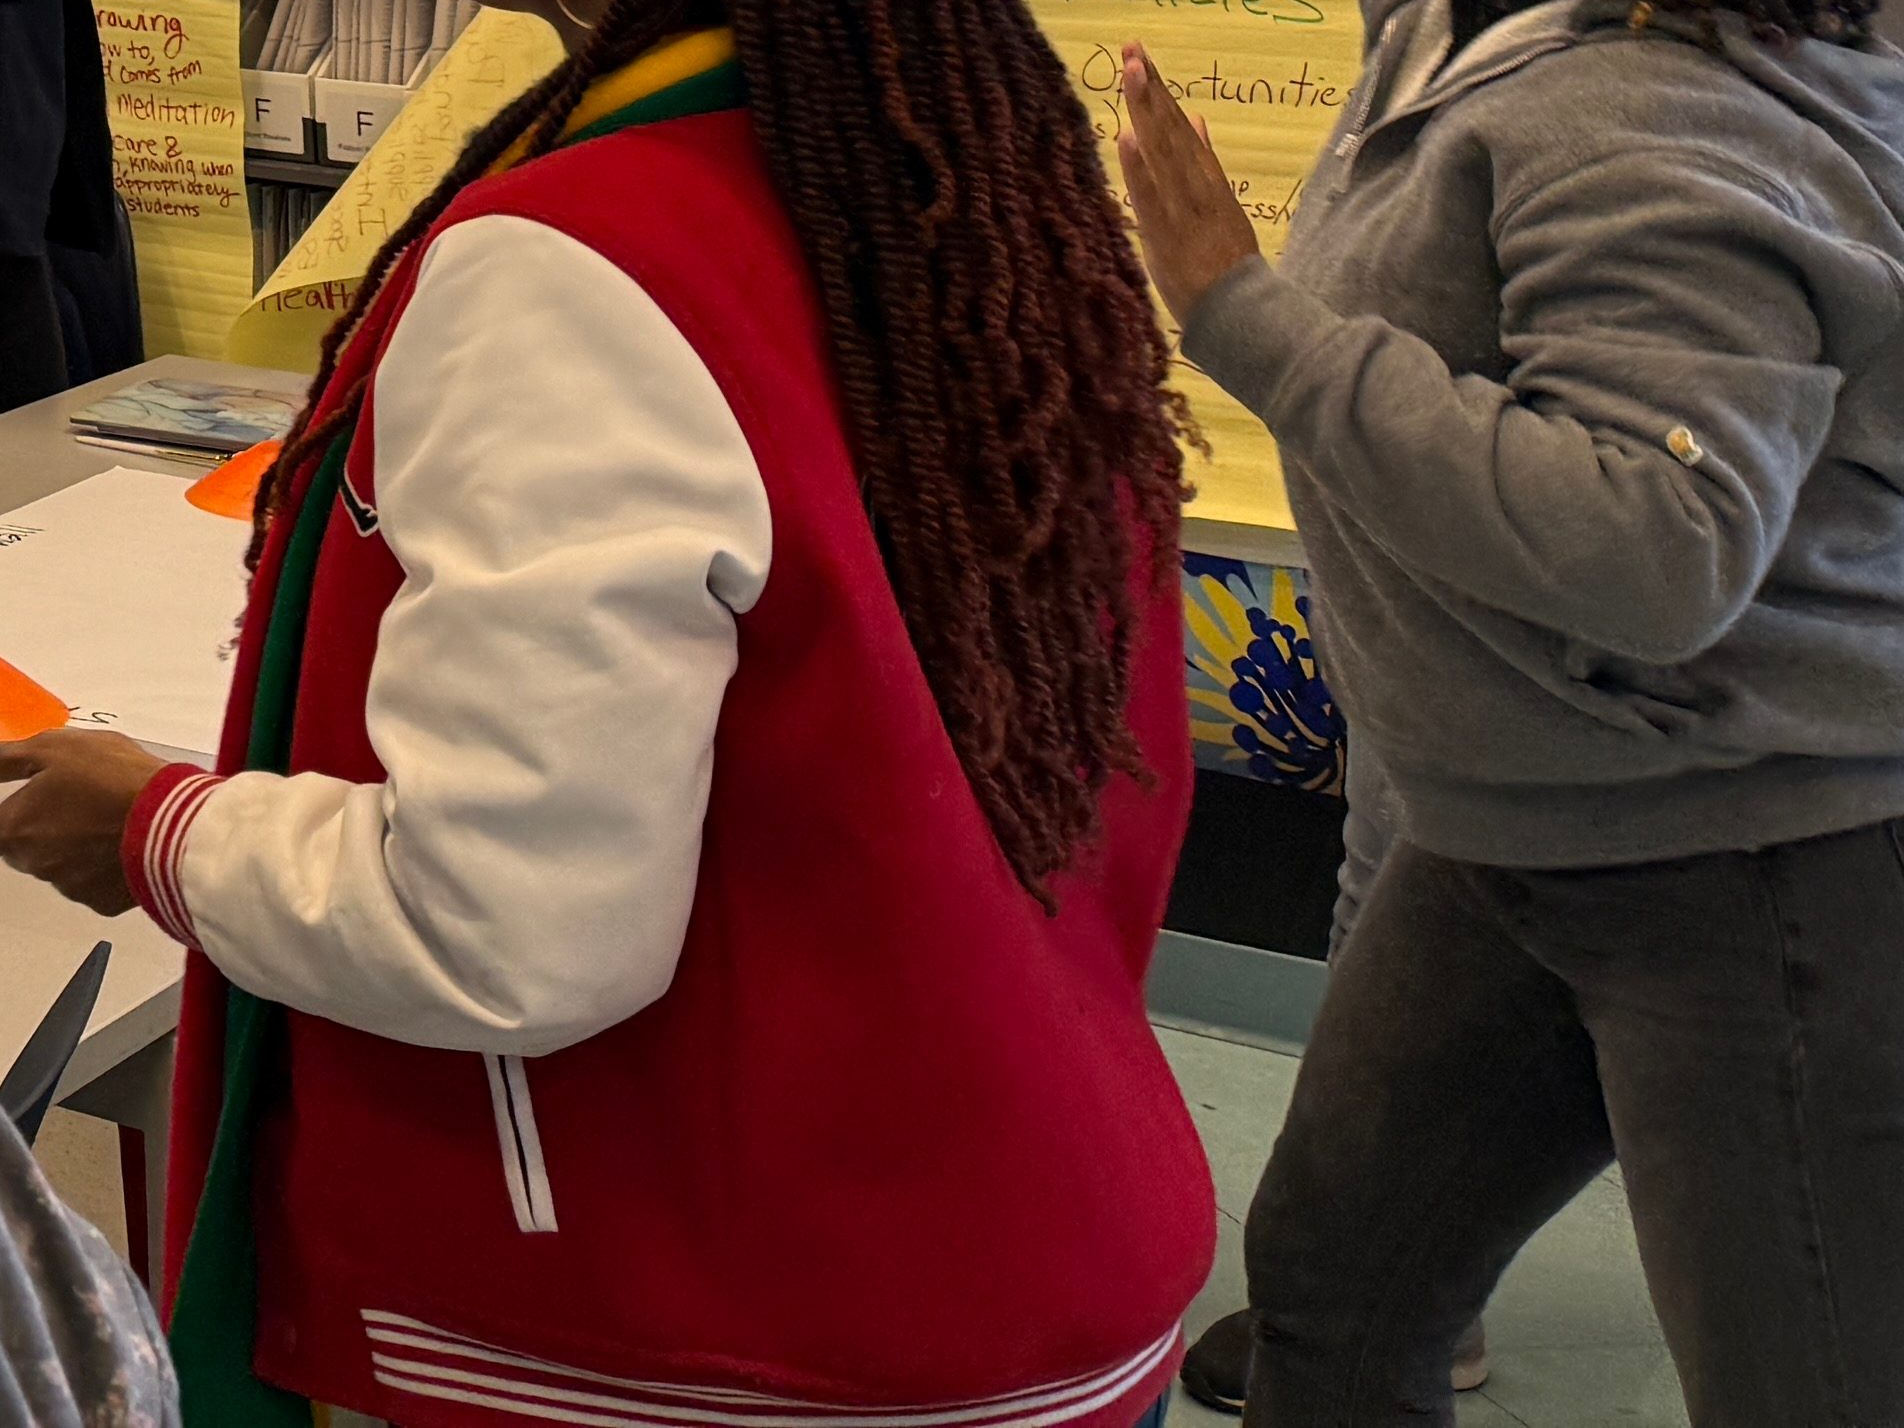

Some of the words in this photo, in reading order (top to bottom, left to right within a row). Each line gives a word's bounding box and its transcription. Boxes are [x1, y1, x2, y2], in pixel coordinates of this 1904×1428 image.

[167, 59, 203, 86] from
[254, 97, 272, 123] F
[356, 110, 374, 137] F
[201, 161, 234, 177] when
[125, 197, 201, 218] students
